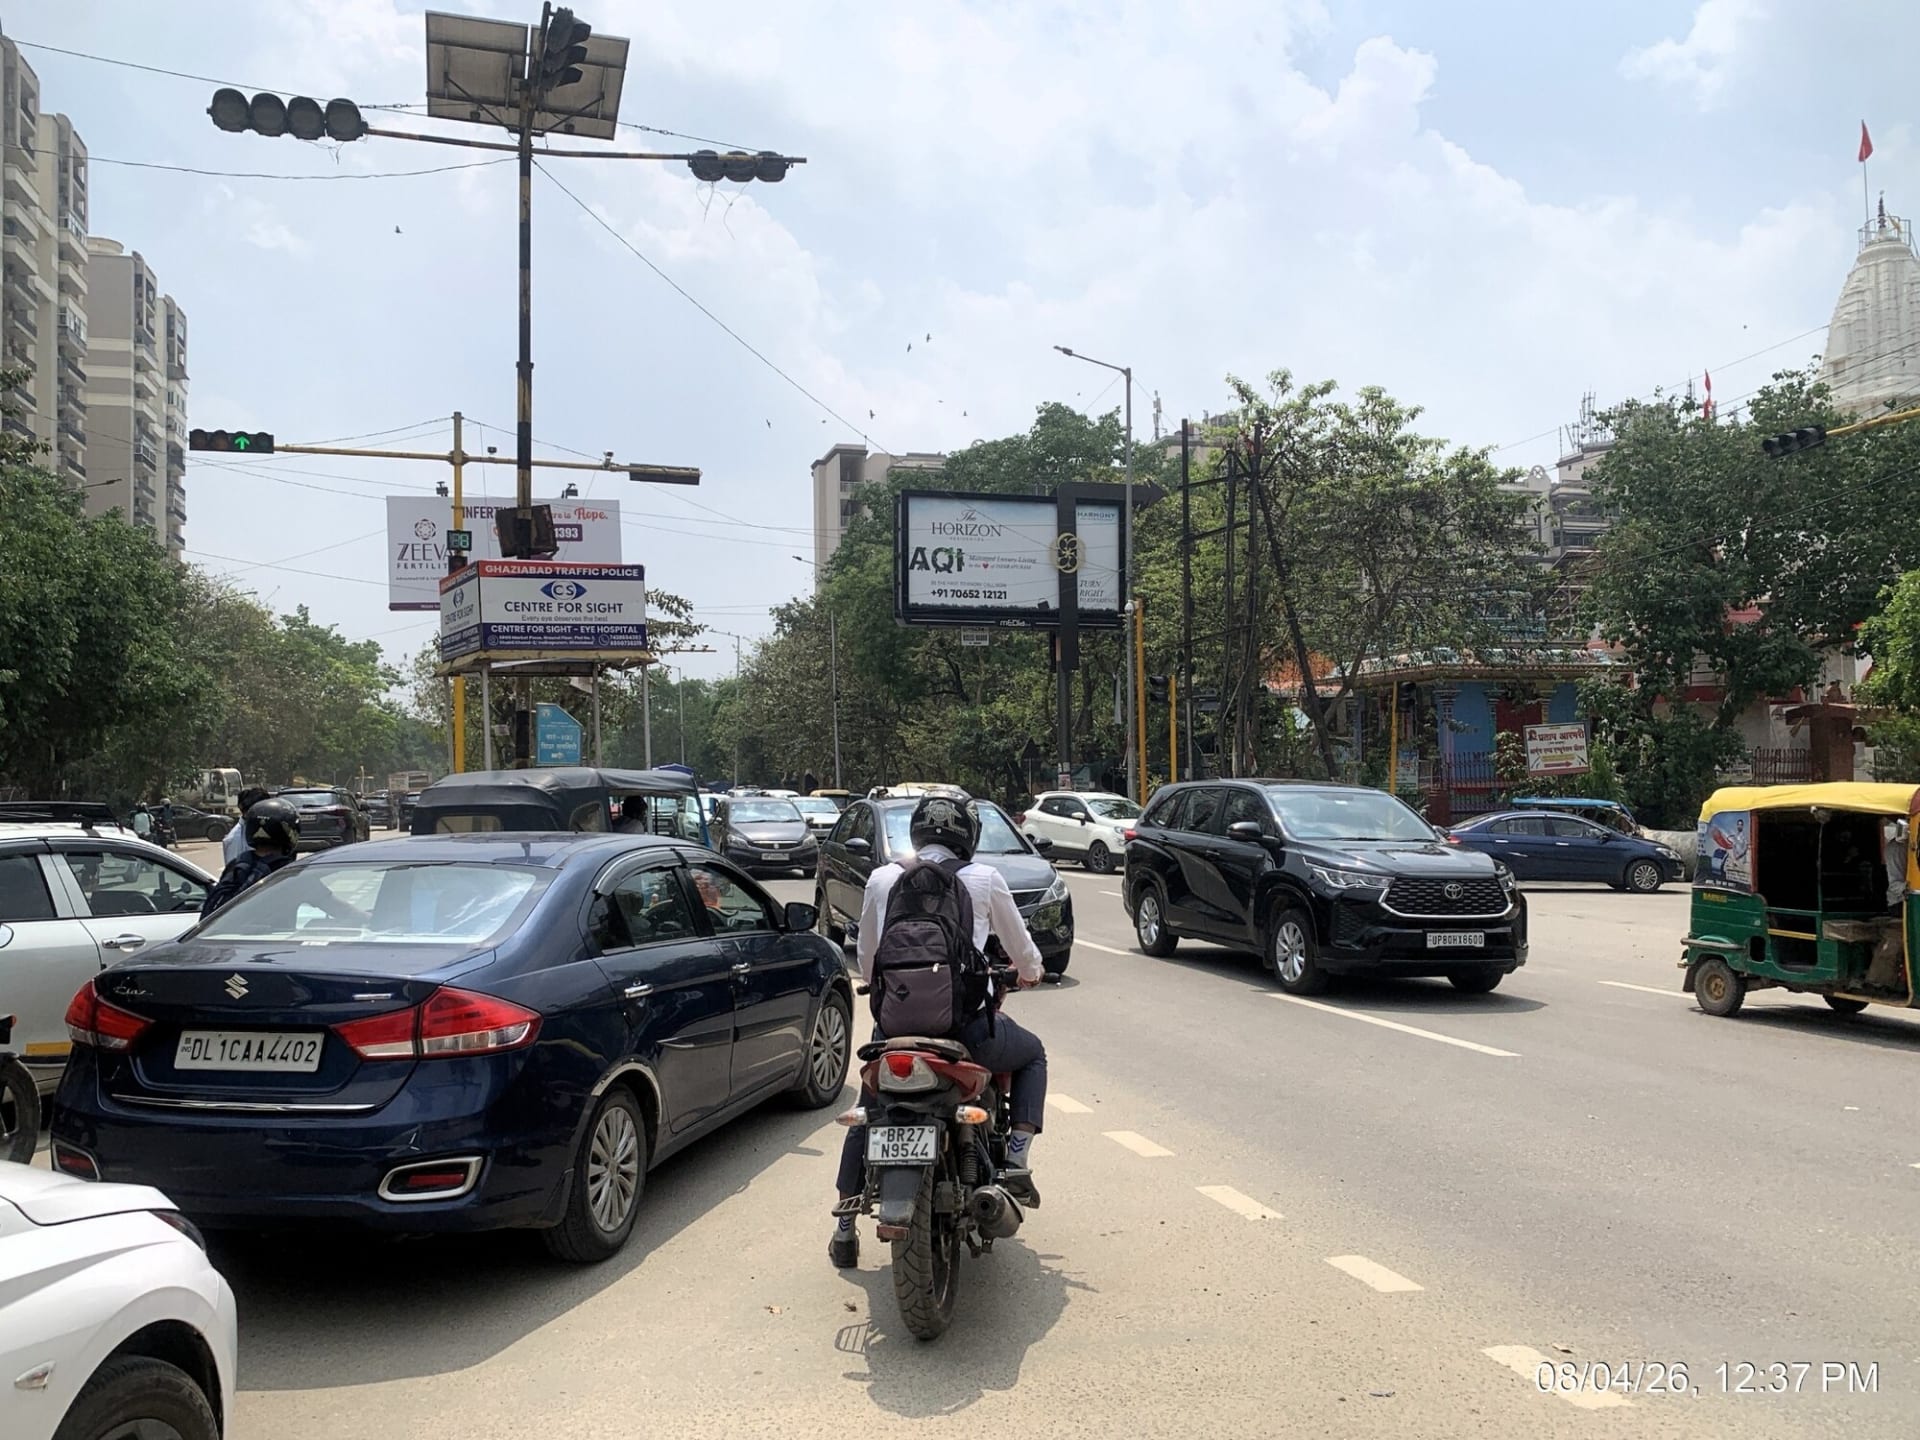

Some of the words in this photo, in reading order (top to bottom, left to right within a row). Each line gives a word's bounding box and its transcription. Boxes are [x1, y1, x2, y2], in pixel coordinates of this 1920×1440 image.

[932, 521, 1002, 537] HORIZON
[396, 562, 448, 570] FERTILIT
[909, 546, 966, 574] AQI
[485, 565, 553, 575] GHAZIABAD
[555, 567, 600, 577] TRAFFIC
[601, 568, 639, 577] POLICE
[1080, 580, 1101, 588] TURN
[931, 588, 948, 598] +91
[950, 589, 980, 599] 70652
[982, 590, 1007, 600] 12121
[1080, 590, 1104, 598] RIGHT
[504, 601, 553, 613] CENTRE
[557, 602, 583, 613] FOR
[585, 602, 624, 614] SIGHT
[490, 625, 526, 633] CENTRE
[526, 625, 545, 633] FOR
[545, 625, 572, 634] SIGHT
[580, 625, 596, 634] EYE
[596, 626, 638, 634] HOSPITAL
[887, 1127, 926, 1142] BR27
[881, 1143, 929, 1158] N9544
